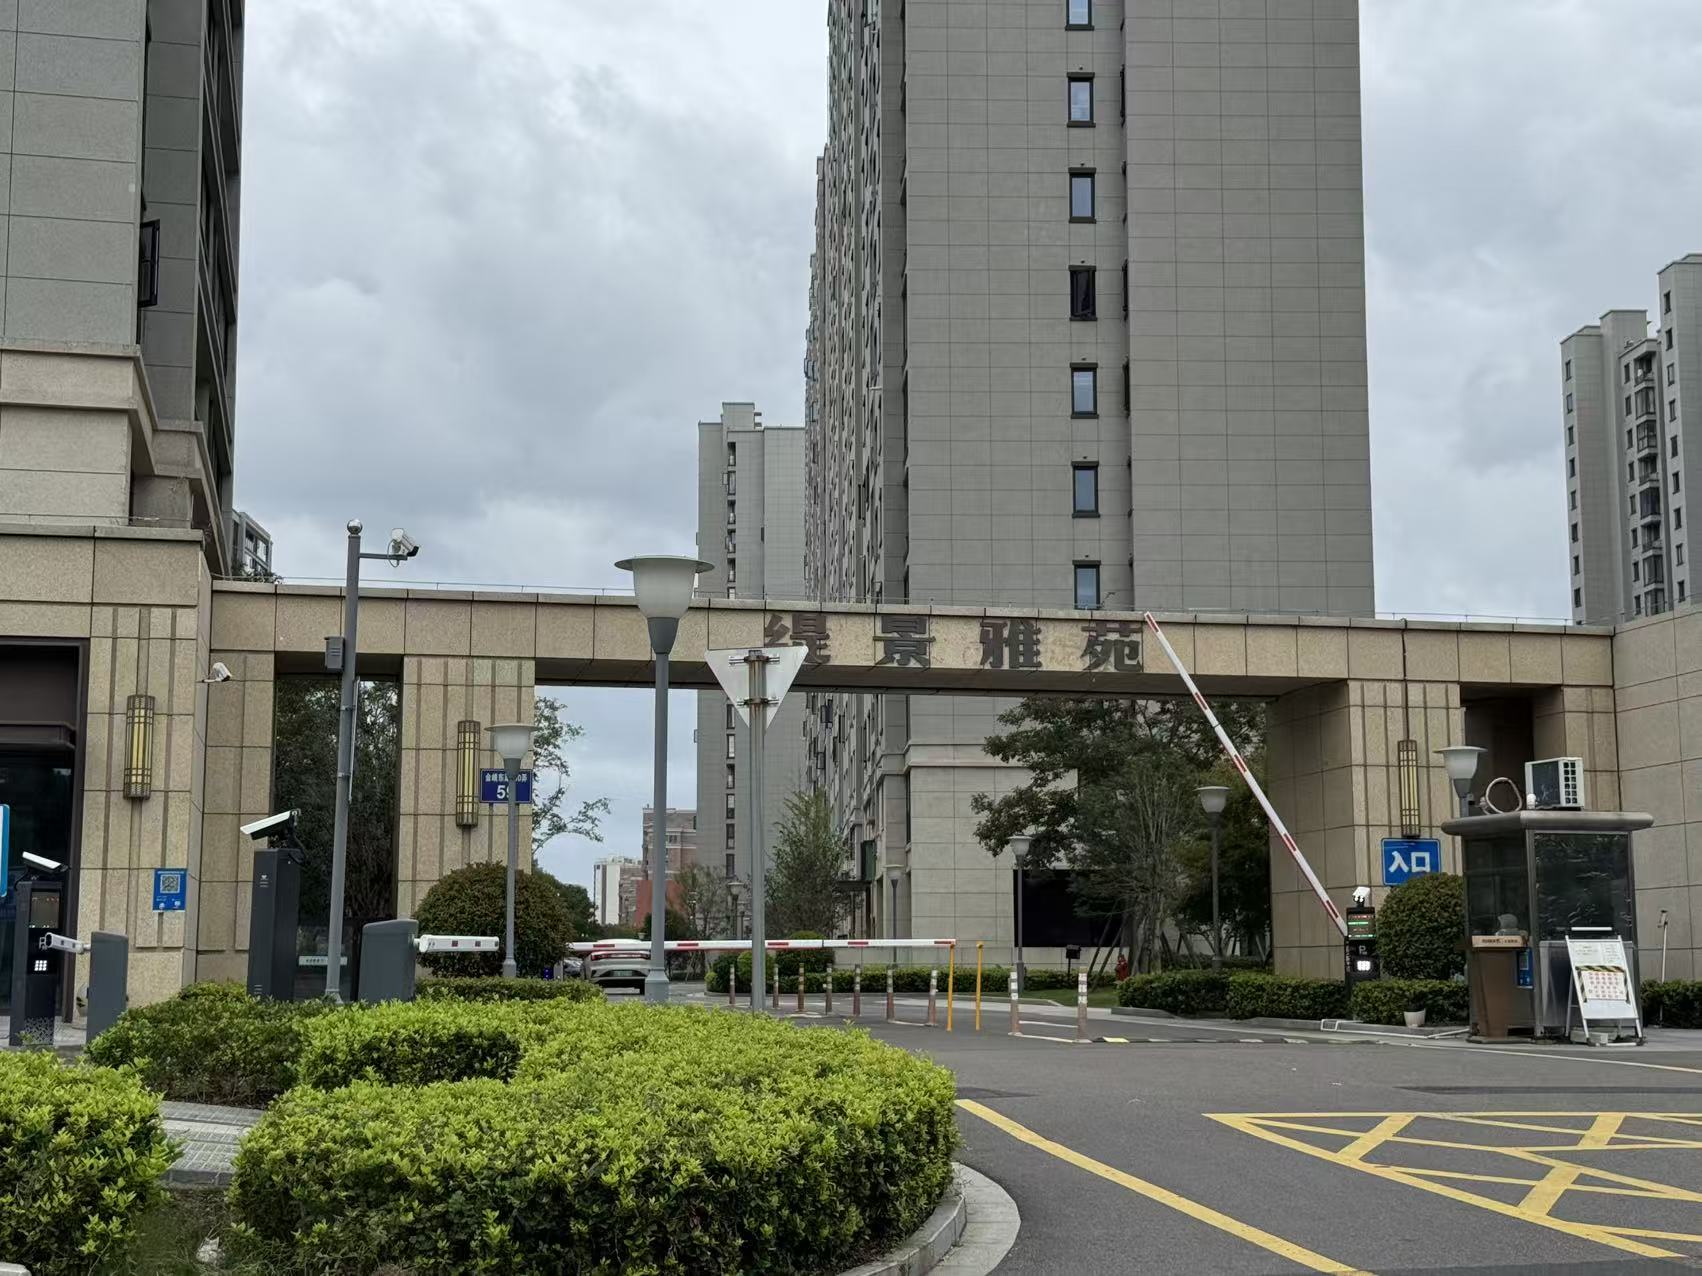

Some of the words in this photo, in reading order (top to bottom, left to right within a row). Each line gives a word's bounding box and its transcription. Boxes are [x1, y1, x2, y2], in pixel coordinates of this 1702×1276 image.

[764, 613, 1142, 671] 缇景雅苑
[1388, 850, 1430, 872] 入口
